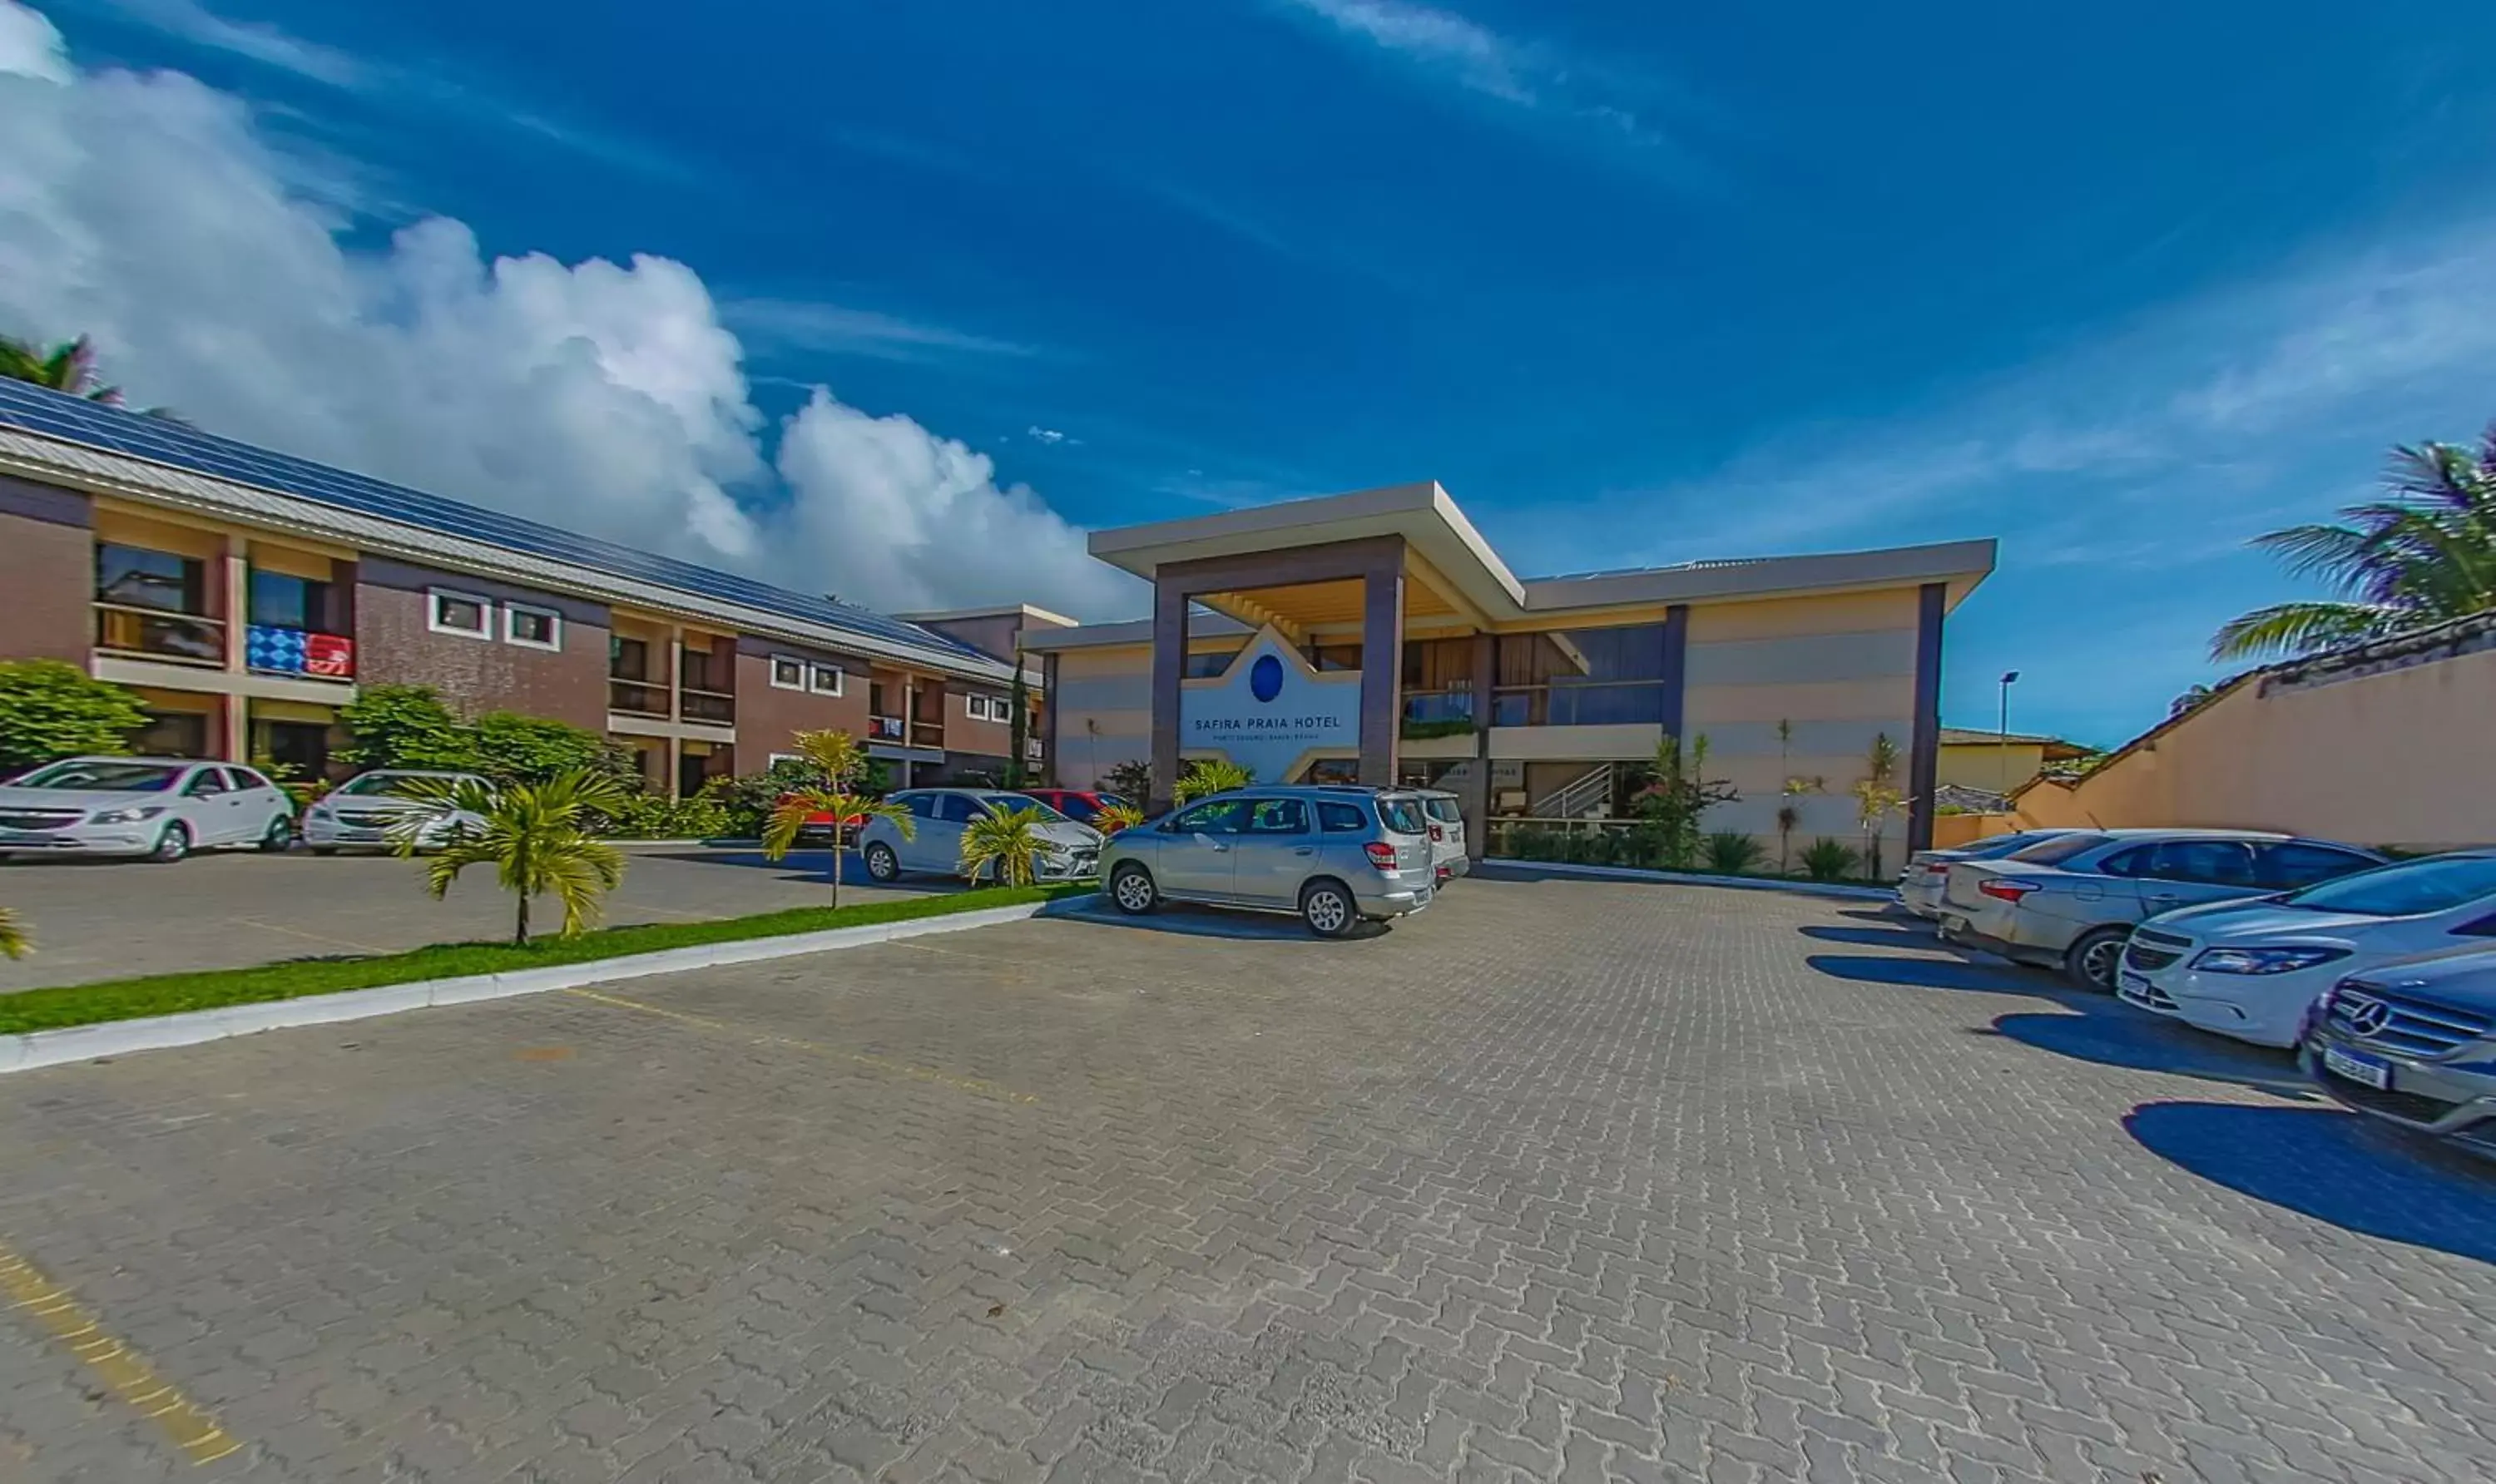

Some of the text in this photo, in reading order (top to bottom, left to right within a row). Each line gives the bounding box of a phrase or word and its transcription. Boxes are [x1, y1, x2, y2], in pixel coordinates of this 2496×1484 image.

[1196, 716, 1341, 731] SAFIRA PRAIA HOTEL
